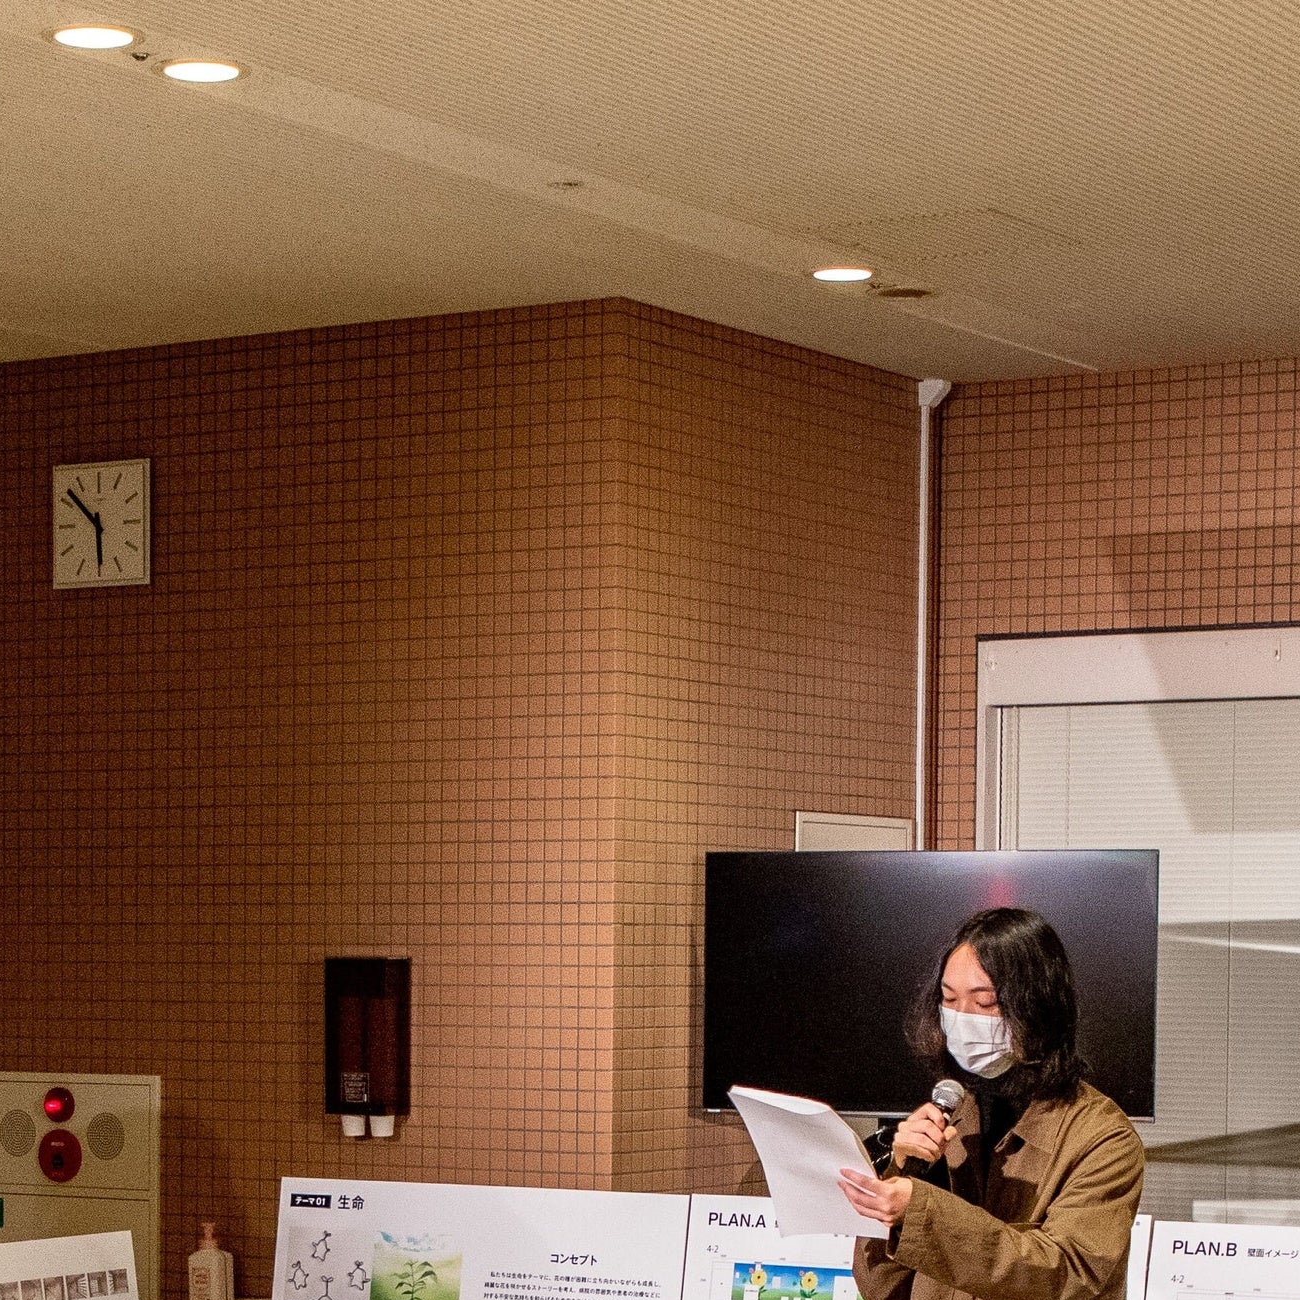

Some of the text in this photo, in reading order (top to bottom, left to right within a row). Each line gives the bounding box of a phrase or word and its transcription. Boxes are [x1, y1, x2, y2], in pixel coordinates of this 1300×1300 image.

[295, 1195, 365, 1210] テーマ01 生命
[708, 1212, 766, 1228] PLAN.A
[706, 1245, 719, 1253] 4-2
[1172, 1240, 1299, 1259] PLAN.B 壁面イメージ
[550, 1254, 598, 1266] コンセプト
[1170, 1274, 1185, 1284] 4-2
